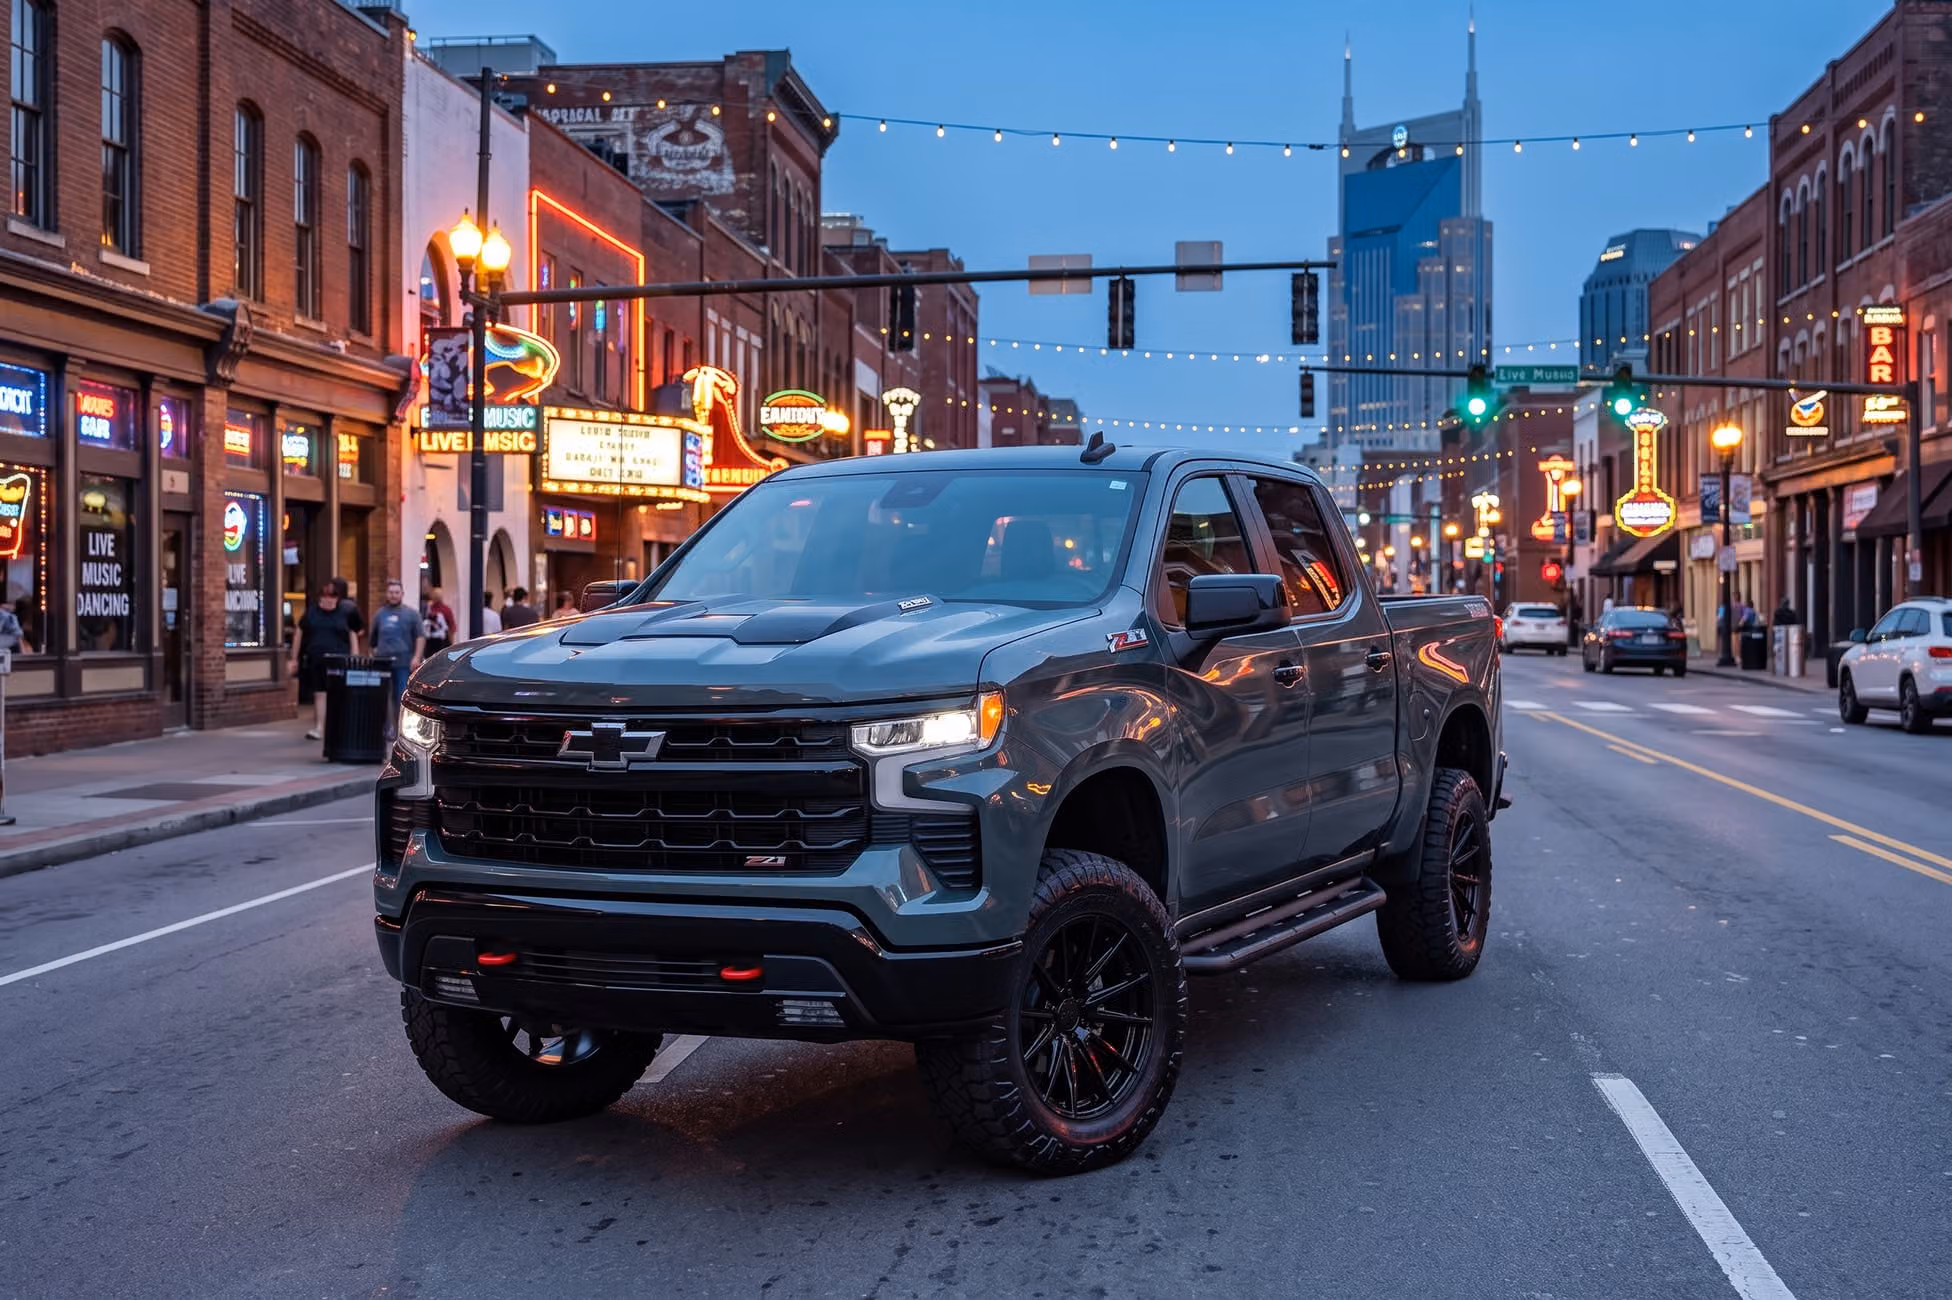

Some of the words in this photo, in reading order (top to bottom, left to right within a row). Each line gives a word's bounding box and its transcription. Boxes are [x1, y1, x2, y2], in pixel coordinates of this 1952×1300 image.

[1870, 326, 1894, 382] BAR
[1499, 367, 1526, 381] Live
[483, 406, 536, 429] MUSIC
[420, 431, 465, 452] LIVE
[88, 532, 116, 557] LIVE
[82, 562, 122, 587] MUSIC
[228, 563, 247, 585] LIVE
[77, 592, 130, 617] DANCING
